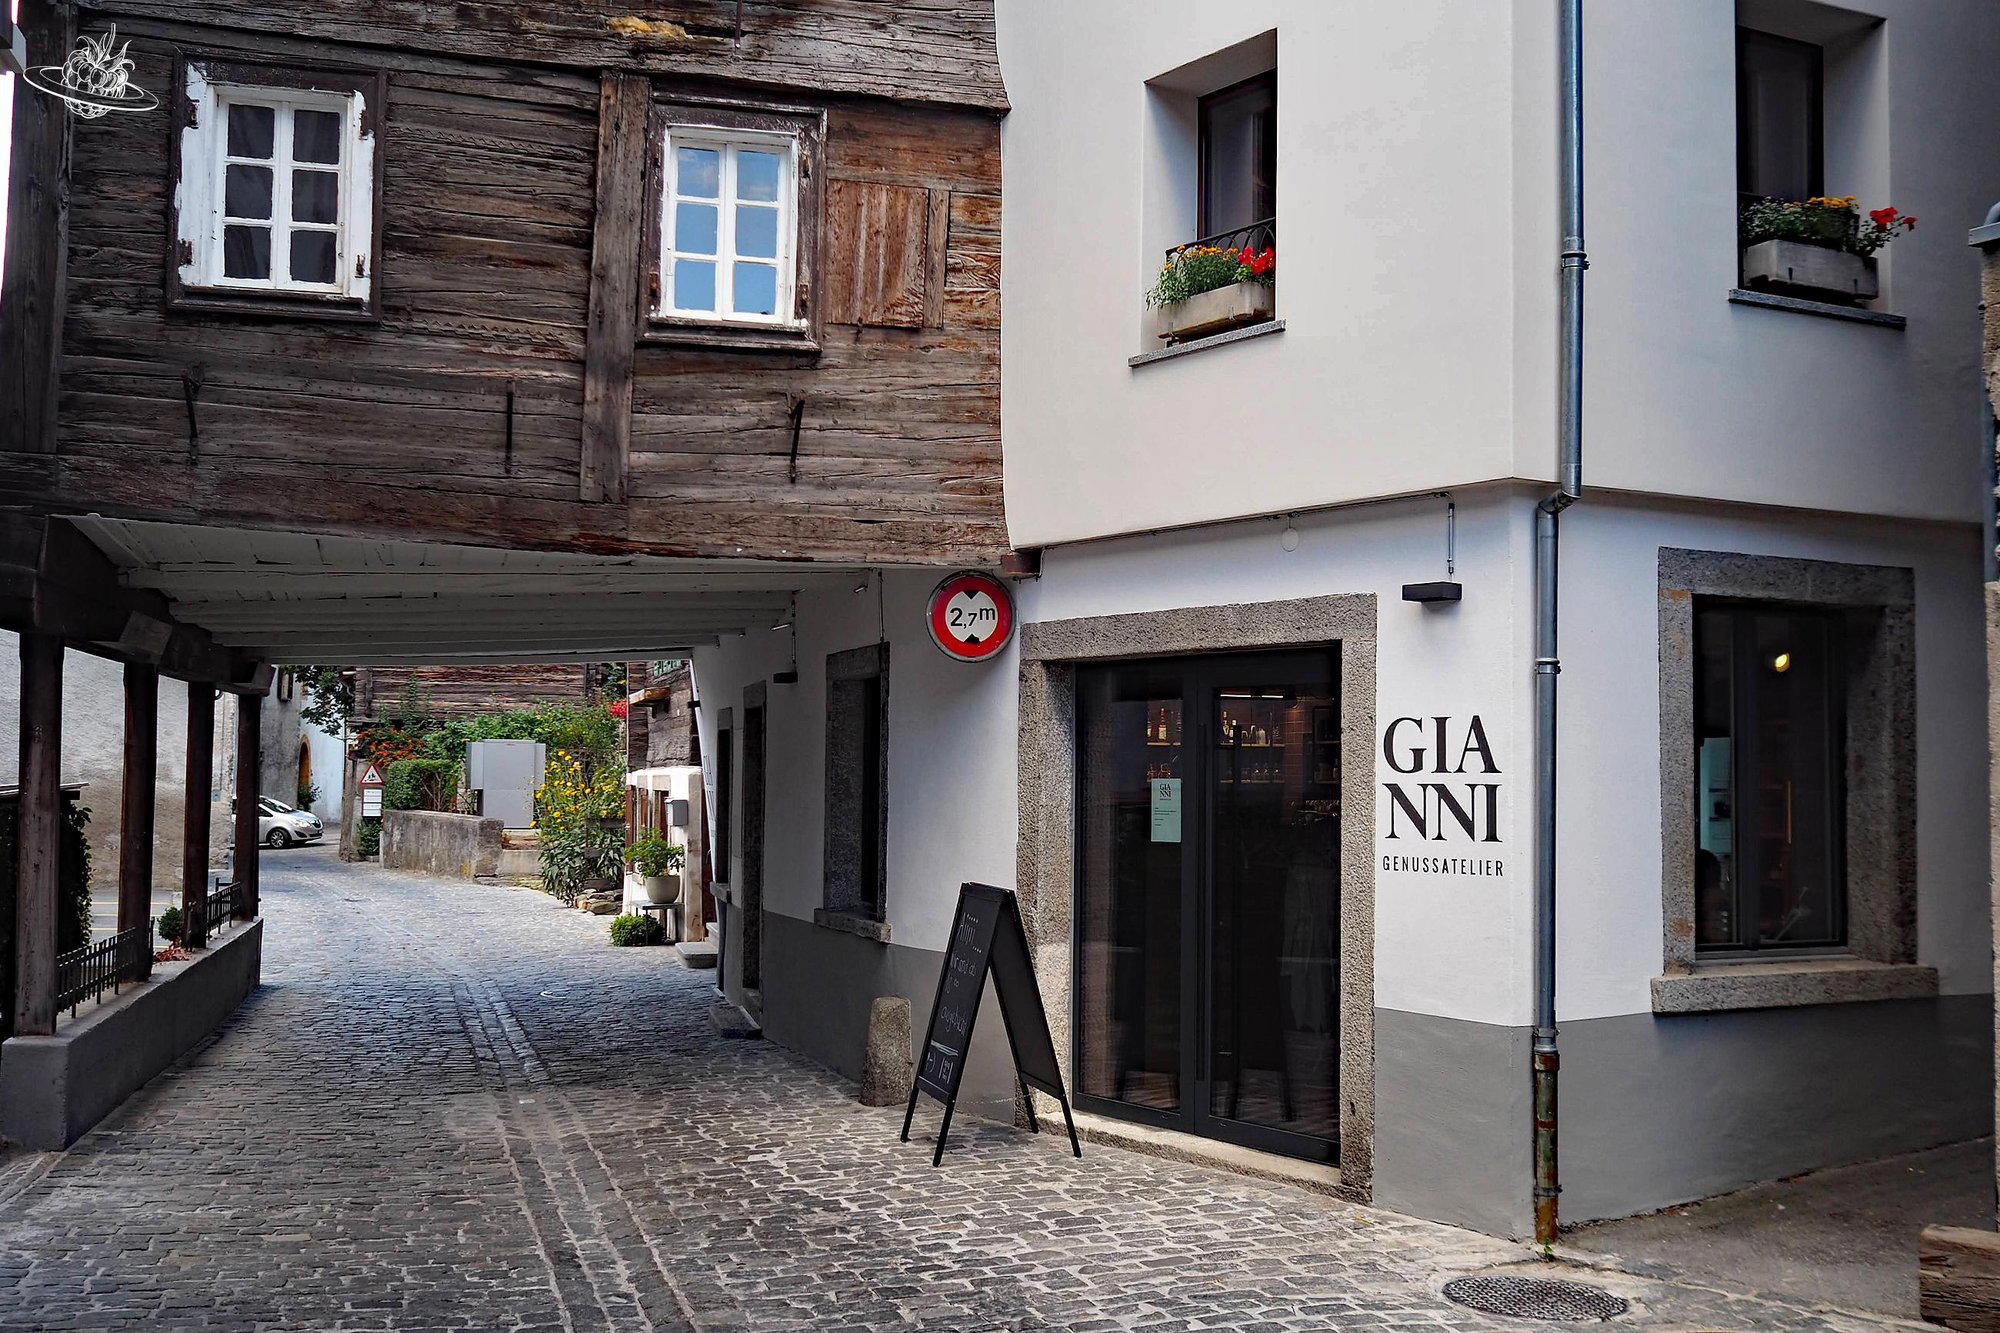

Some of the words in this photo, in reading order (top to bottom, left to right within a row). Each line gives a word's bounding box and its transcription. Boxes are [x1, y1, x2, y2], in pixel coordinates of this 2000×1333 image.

[950, 607, 995, 629] 2,7m
[1383, 715, 1502, 774] GIA
[1382, 783, 1503, 842] NNI
[1383, 855, 1504, 876] GENUSSATELIER
